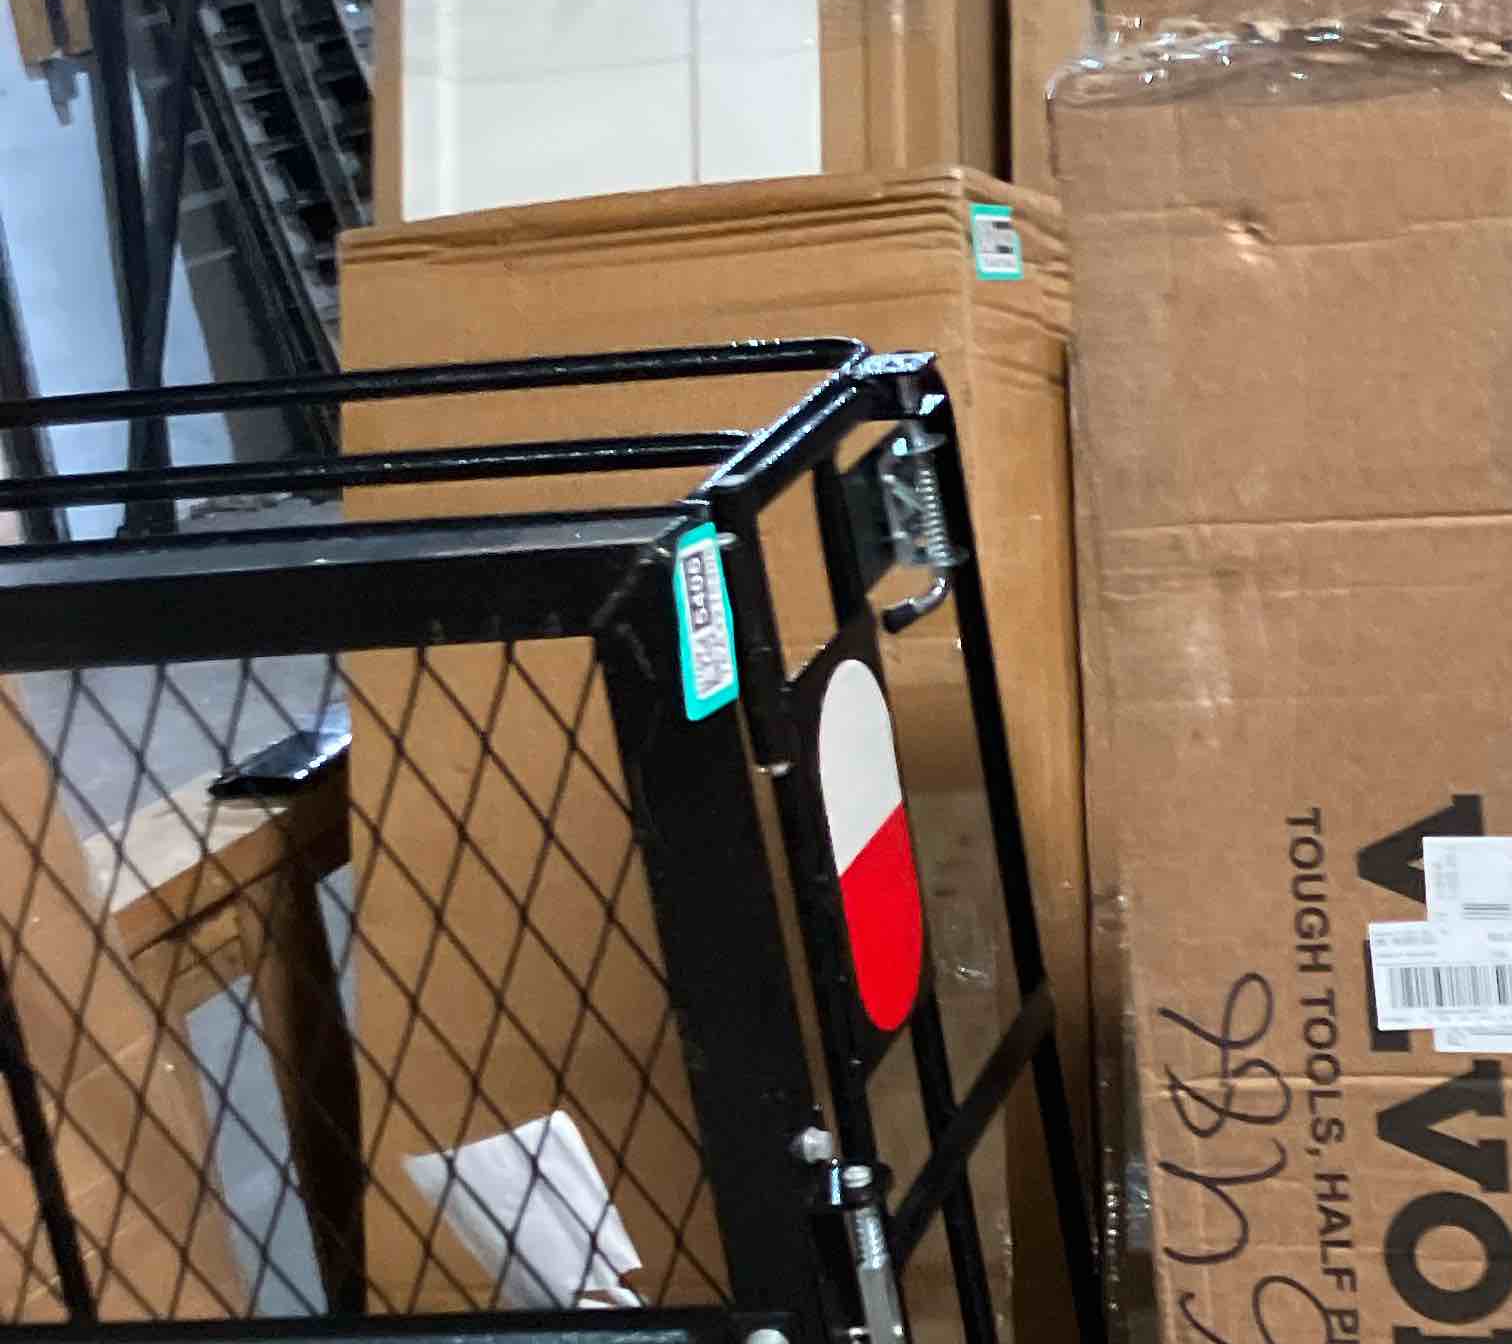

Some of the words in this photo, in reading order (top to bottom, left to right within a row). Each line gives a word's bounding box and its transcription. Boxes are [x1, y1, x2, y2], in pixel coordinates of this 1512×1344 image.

[1285, 807, 1332, 974] TOUGH
[1299, 988, 1345, 1158] TOOLS,
[1312, 1172, 1358, 1293] HALF
